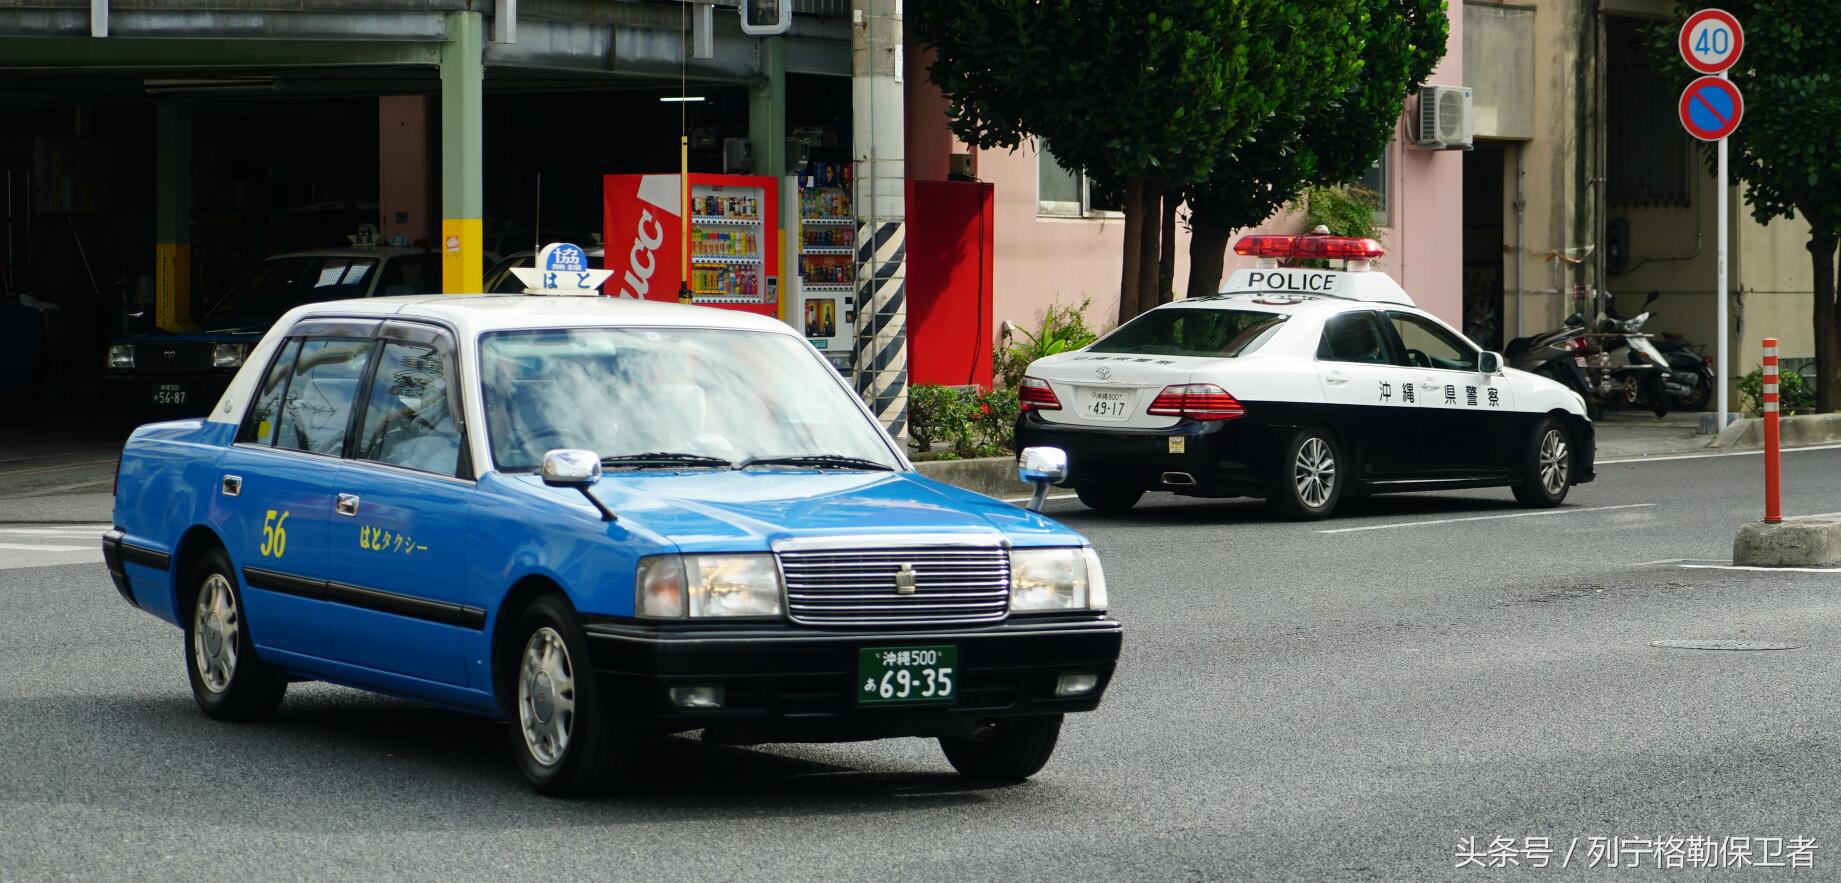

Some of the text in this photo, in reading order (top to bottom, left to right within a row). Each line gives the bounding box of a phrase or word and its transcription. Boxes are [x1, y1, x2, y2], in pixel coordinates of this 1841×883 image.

[1695, 27, 1728, 55] 40
[553, 247, 580, 264] 協
[1248, 272, 1336, 291] POLICE
[159, 391, 186, 404] 56-87
[1093, 401, 1125, 416] 49-17
[260, 510, 289, 558] 56
[360, 525, 428, 554] はとタクシー
[882, 650, 936, 666] 沖縄500
[864, 667, 953, 698] あ 69-35
